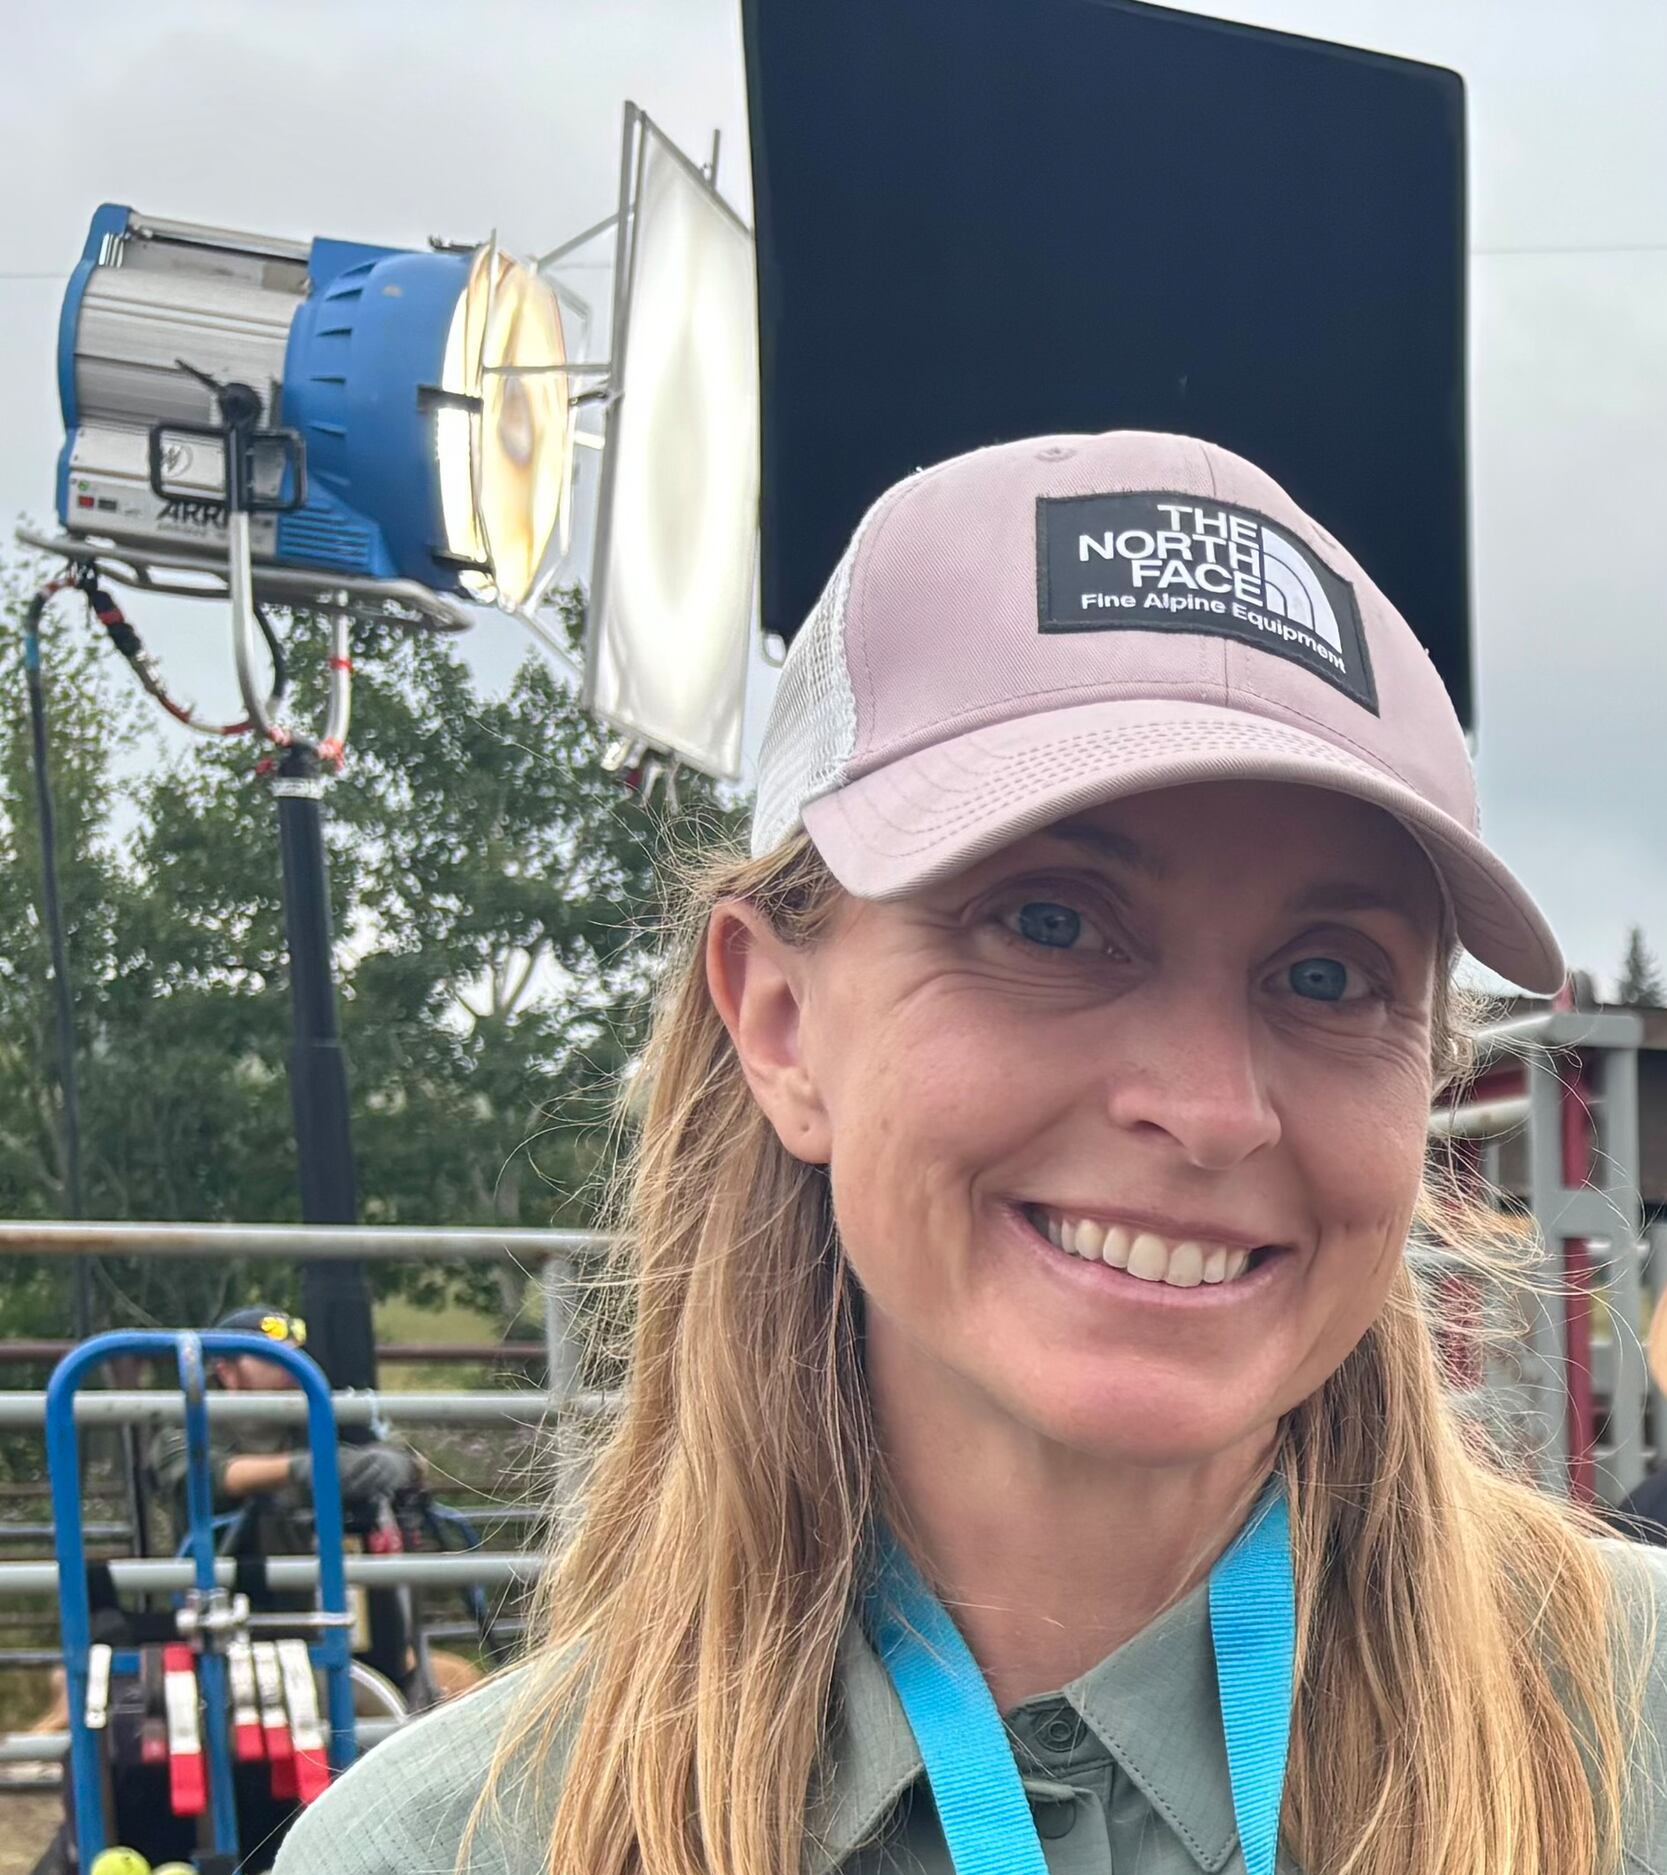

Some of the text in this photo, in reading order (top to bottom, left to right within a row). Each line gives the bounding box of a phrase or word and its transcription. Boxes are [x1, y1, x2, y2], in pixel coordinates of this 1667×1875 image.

[1157, 504, 1258, 546] THE
[1079, 530, 1260, 577] NORTH
[1131, 559, 1263, 607] FACE
[1081, 592, 1346, 674] Fine Alpine Equipment
